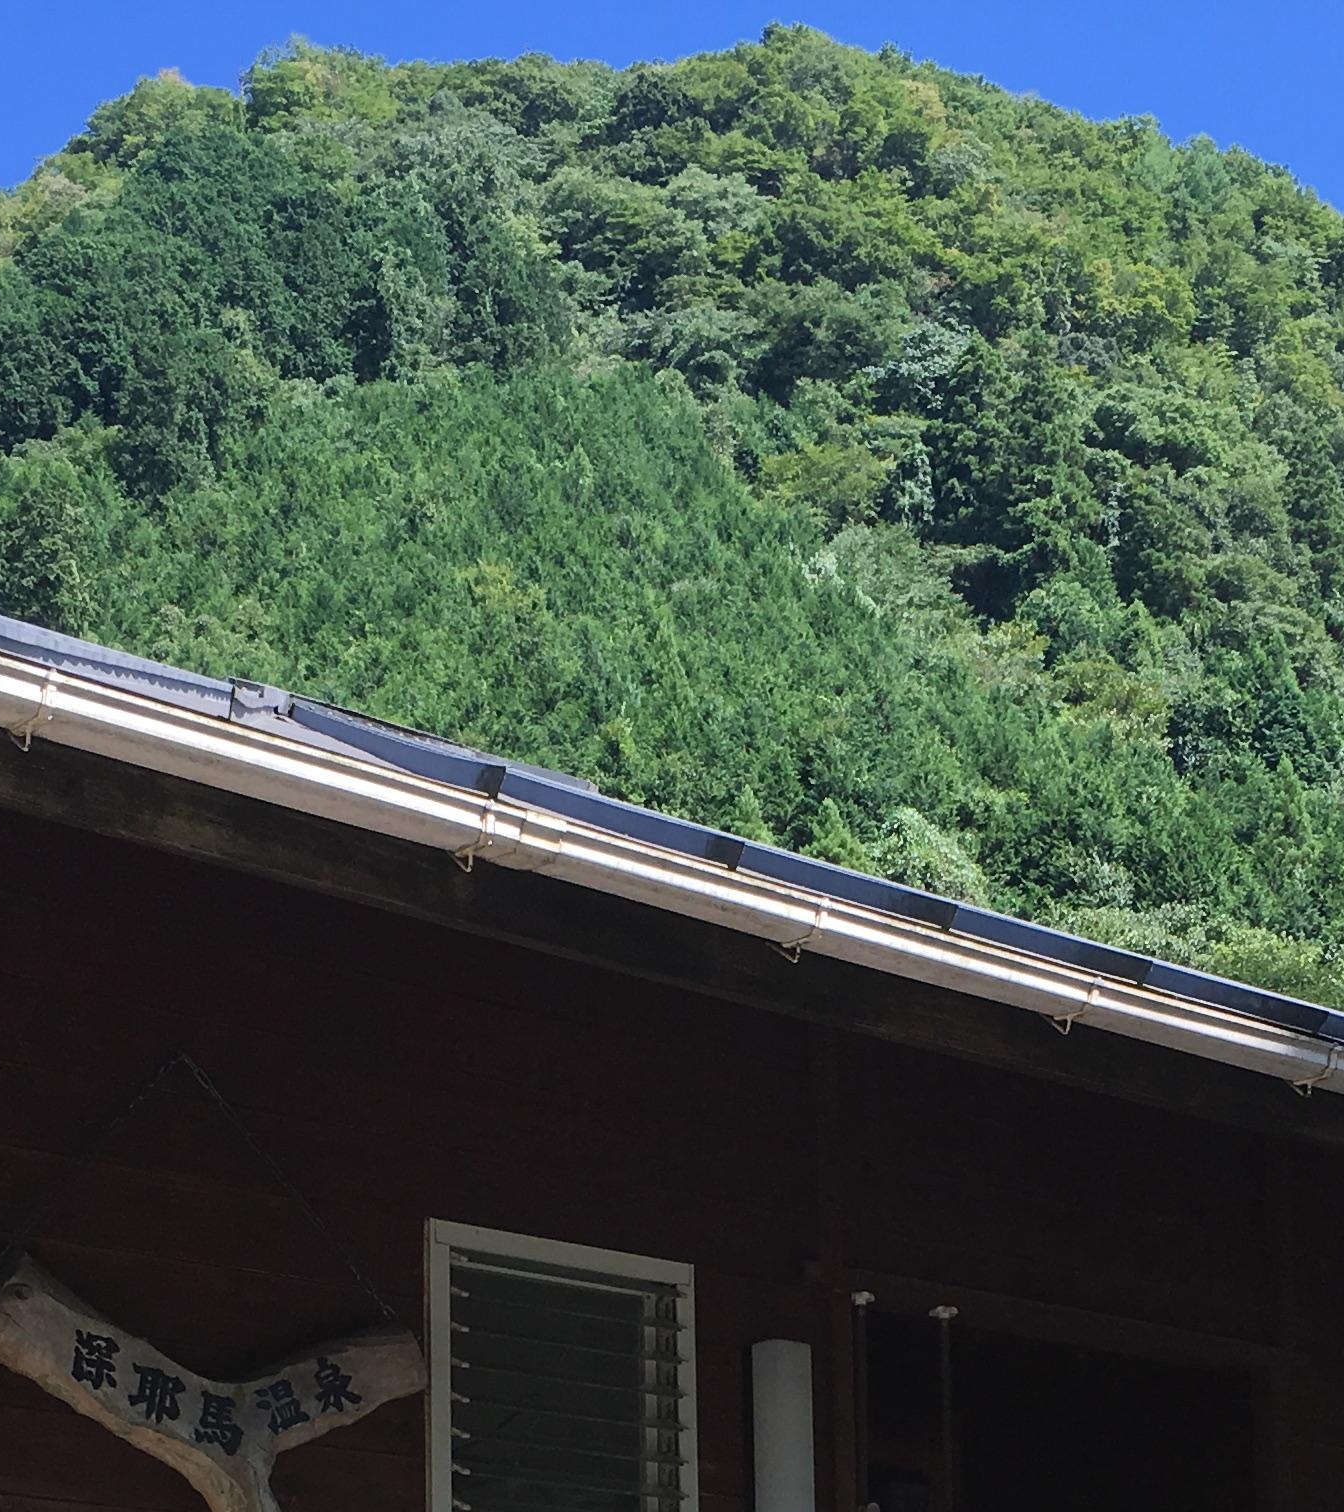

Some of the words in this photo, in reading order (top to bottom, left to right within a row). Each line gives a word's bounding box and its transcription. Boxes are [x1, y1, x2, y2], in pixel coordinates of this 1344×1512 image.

[71, 1329, 362, 1456] 深耶馬温泉
